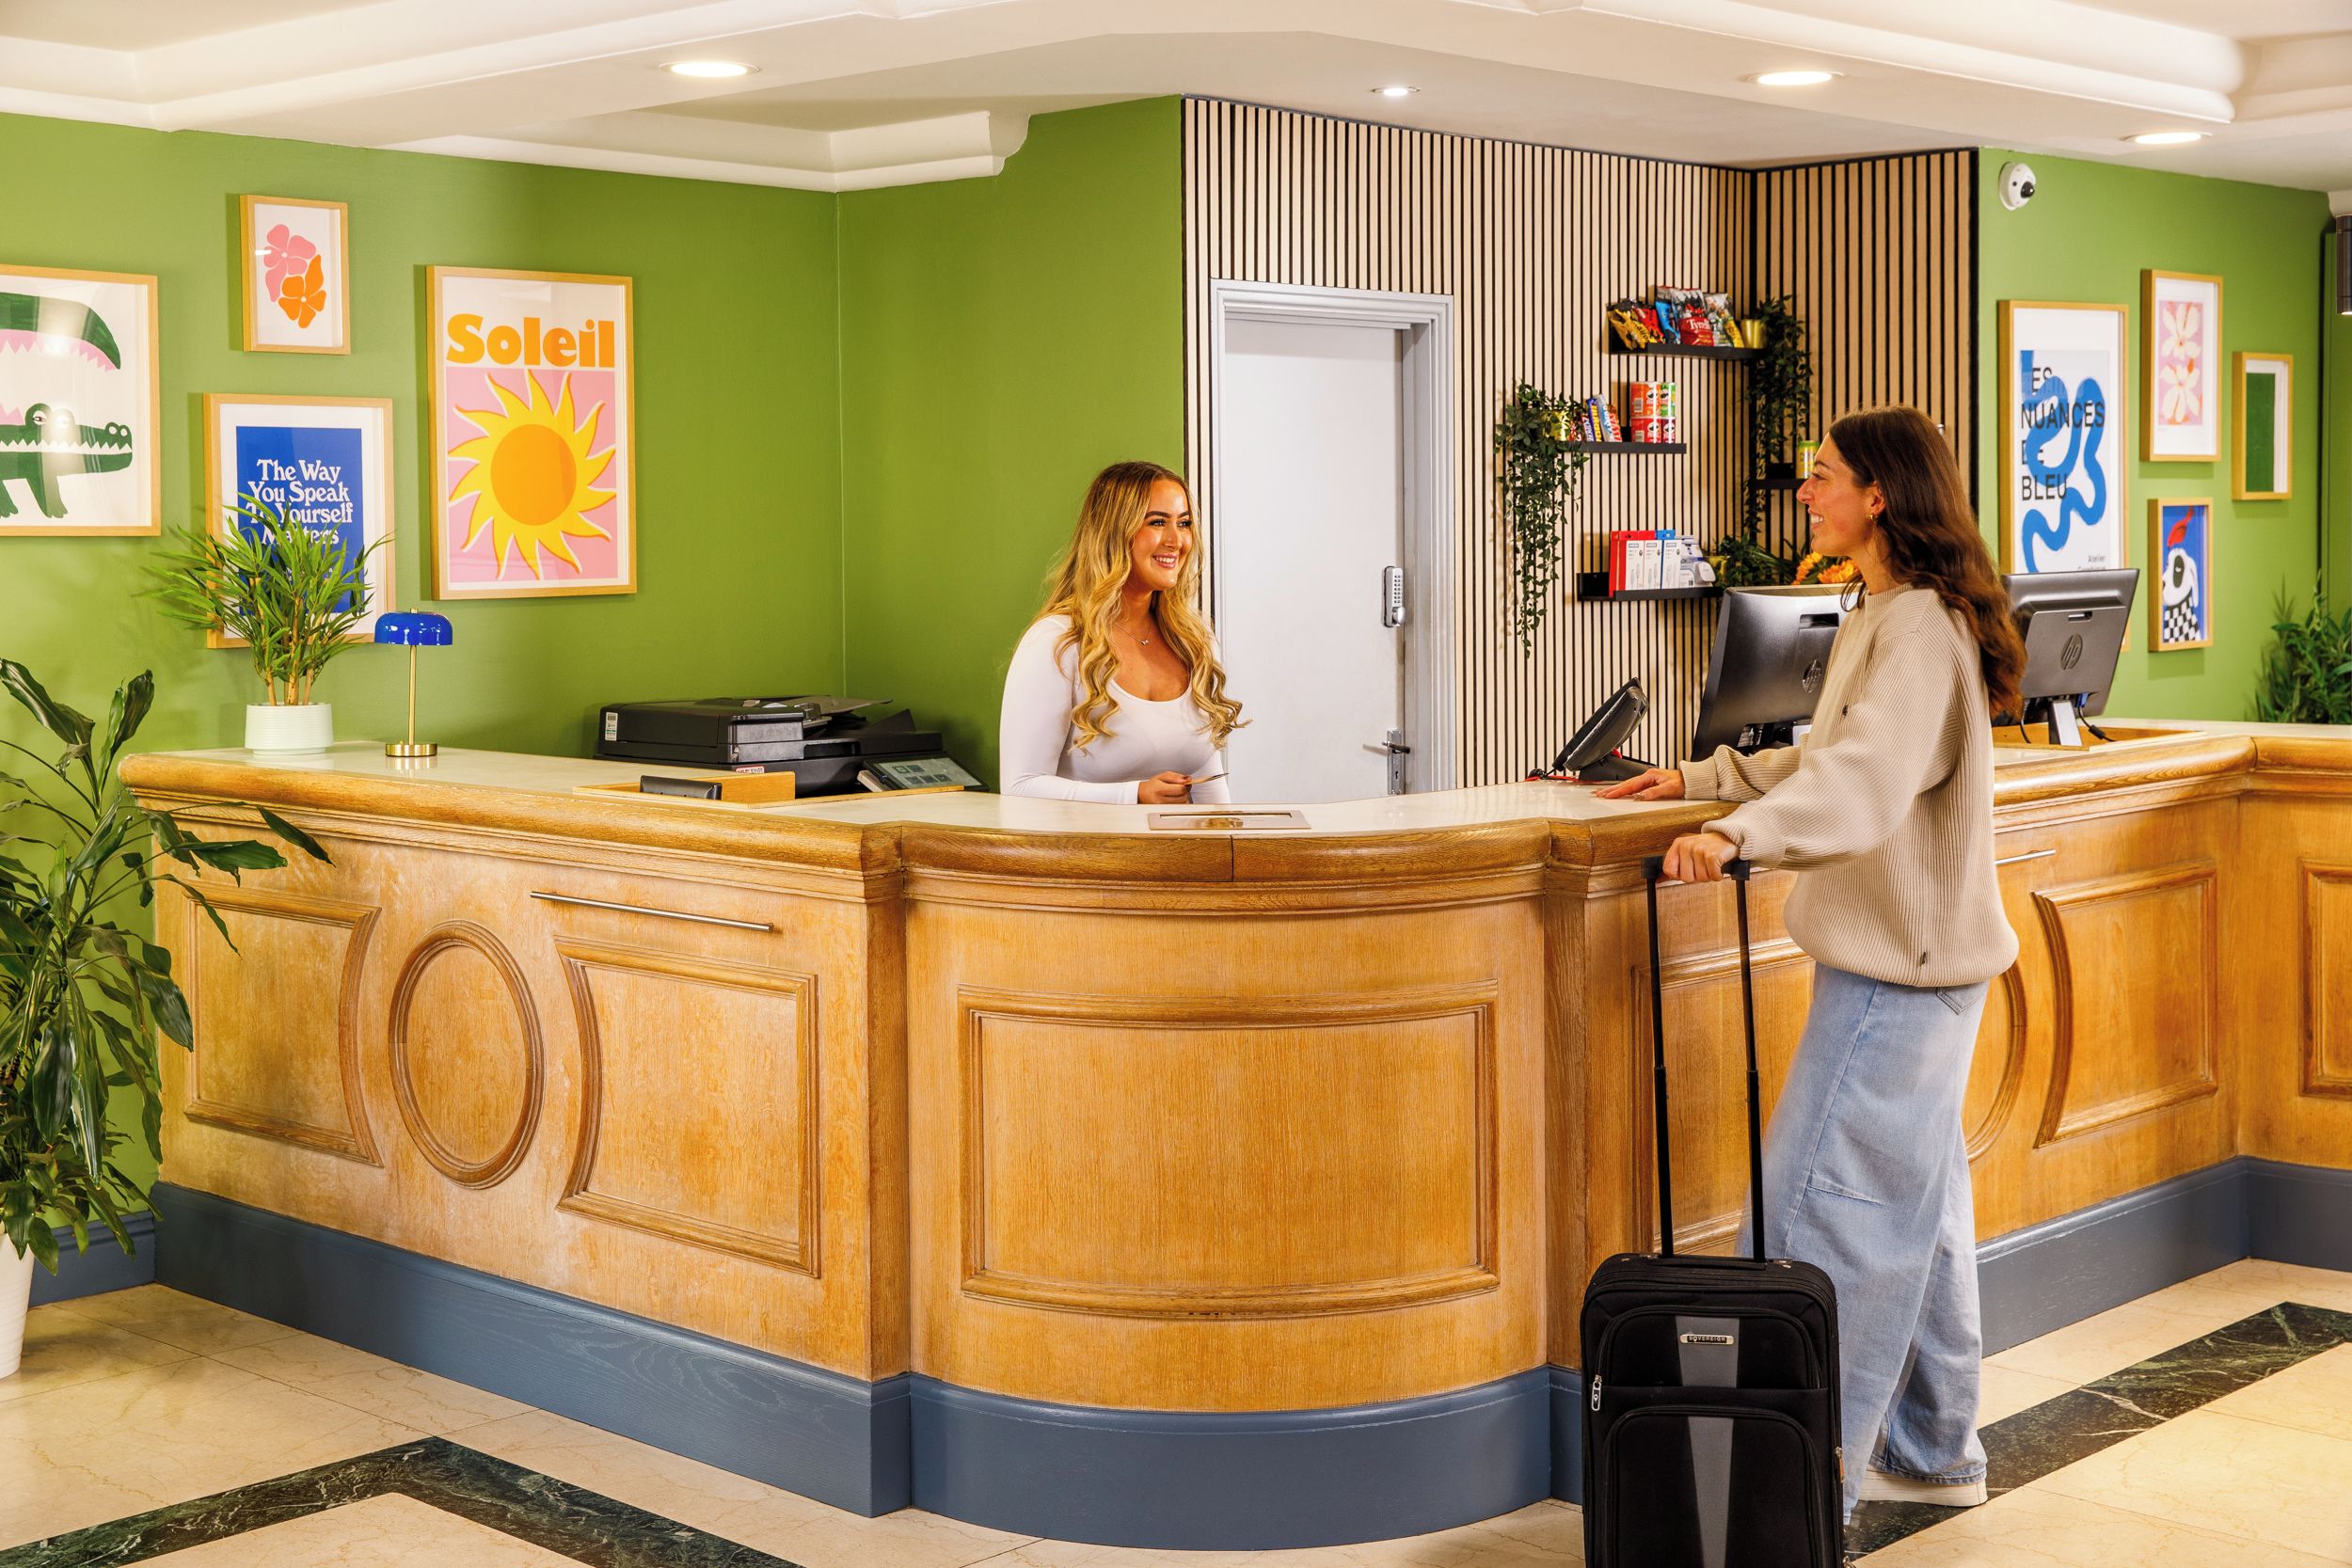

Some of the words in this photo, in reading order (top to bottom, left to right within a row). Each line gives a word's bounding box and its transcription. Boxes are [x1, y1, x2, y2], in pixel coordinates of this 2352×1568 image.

[446, 313, 615, 368] Soleil
[2021, 402, 2106, 429] NUANCES
[256, 459, 296, 481] The
[298, 459, 342, 484] Way
[247, 481, 286, 502] You
[289, 481, 350, 506] Speak
[2022, 473, 2068, 501] BLEU
[275, 501, 354, 524] Yourself
